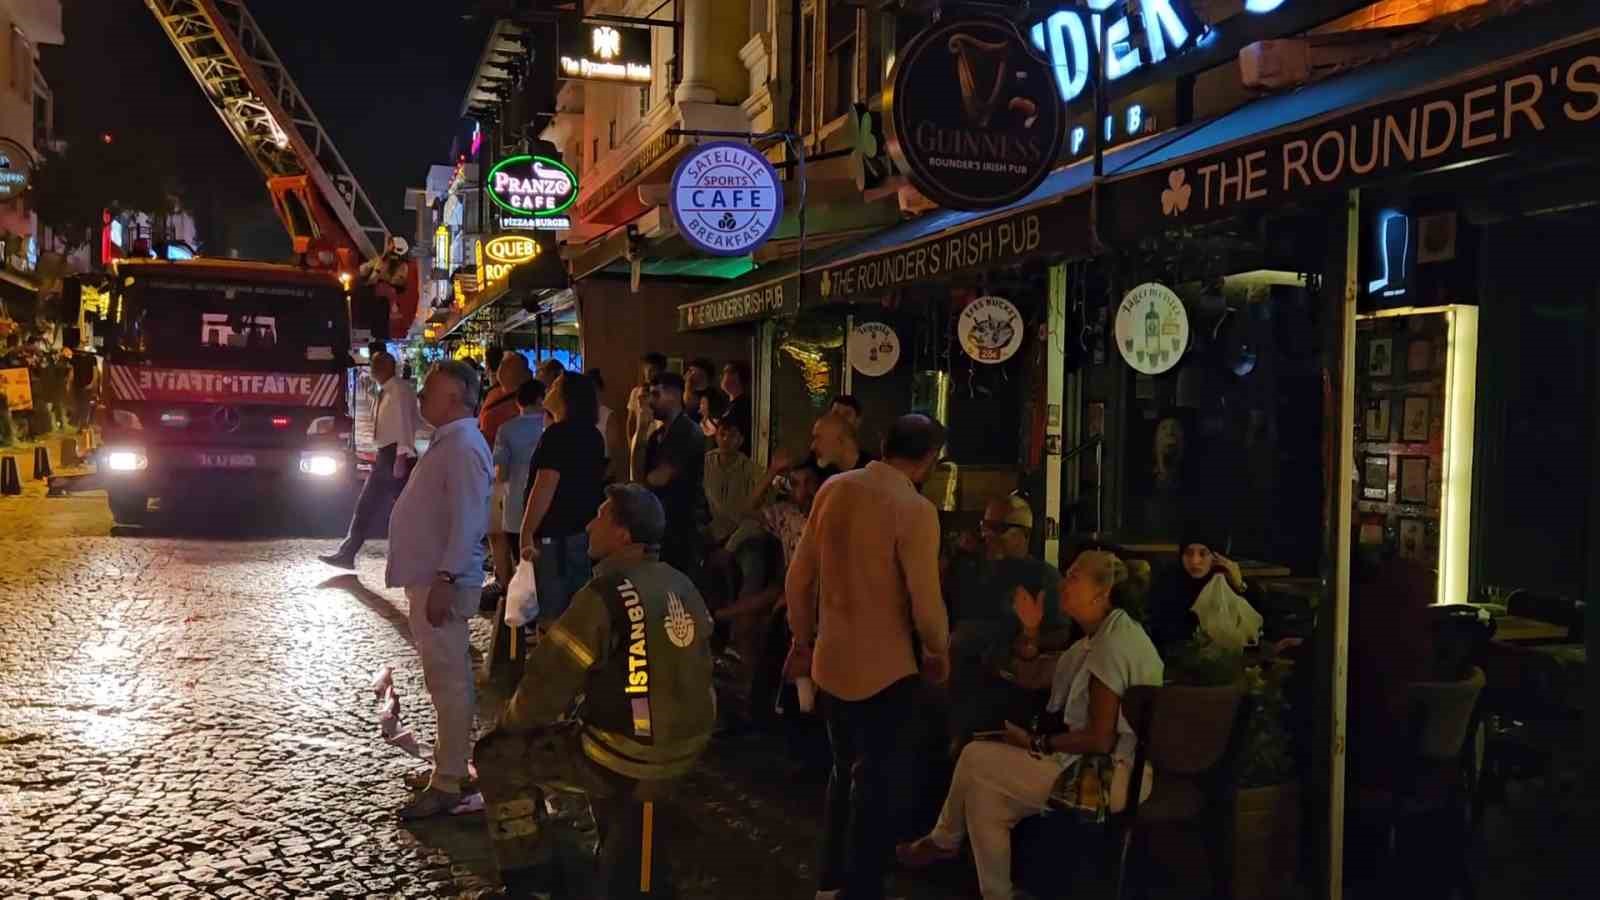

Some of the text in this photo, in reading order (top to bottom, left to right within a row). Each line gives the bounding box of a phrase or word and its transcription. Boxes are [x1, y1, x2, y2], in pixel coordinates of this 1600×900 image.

[915, 120, 1041, 161] GUINNESS
[1197, 55, 1600, 208] THE ROUNDER'S
[688, 152, 765, 180] SATELLITE
[928, 156, 1028, 176] ROUNDER'S IRISH PUB
[495, 172, 571, 195] PRANZO
[703, 175, 748, 186] SPORTS
[511, 196, 556, 210] CAFE
[692, 190, 761, 208] CAFE
[688, 219, 766, 249] BREAKFAST
[832, 214, 1041, 297] THE ROUNDER'S IRISH PUB
